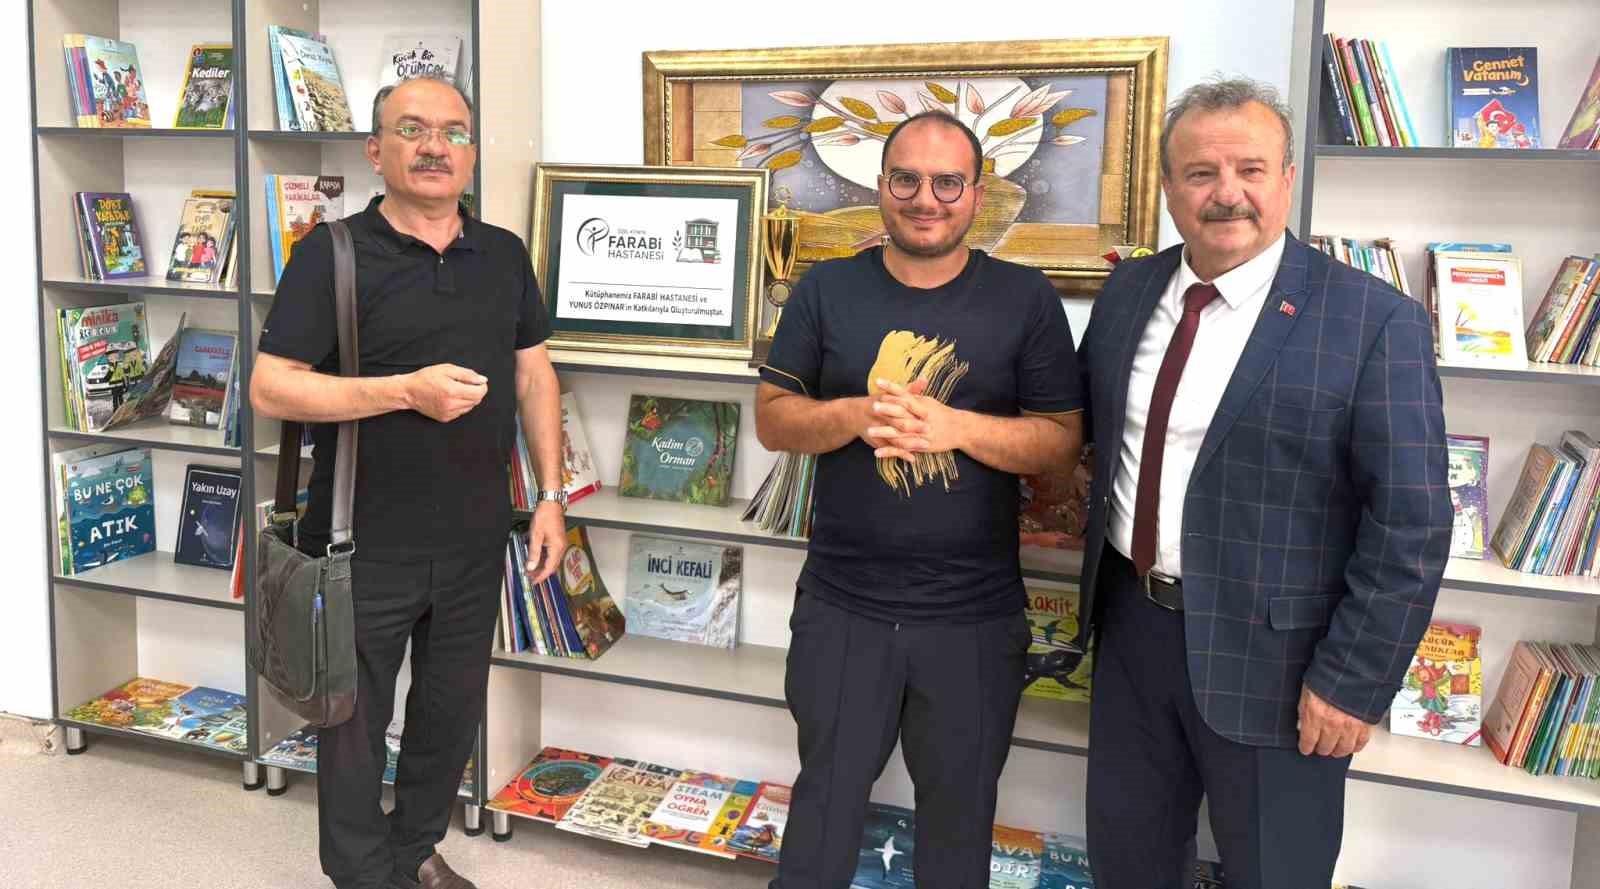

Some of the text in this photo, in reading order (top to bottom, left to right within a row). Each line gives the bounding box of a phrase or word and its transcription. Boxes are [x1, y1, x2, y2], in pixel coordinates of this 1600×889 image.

[421, 49, 435, 61] Bir
[1473, 55, 1526, 72] Cennet
[192, 66, 231, 79] Kediler
[1463, 69, 1522, 82] Vatanım
[585, 289, 708, 304] Kütüphanemiz FARABİ HASTANESİ ve
[569, 301, 593, 310] YUNUS
[633, 303, 669, 315] Katkılarıyla
[81, 307, 119, 328] minika
[651, 437, 684, 452] Kadim
[660, 451, 696, 466] Orman
[73, 474, 144, 502] BU NE ÇOK
[192, 481, 237, 500] Yakın Uzay
[90, 515, 139, 544] ATIK
[648, 553, 713, 579] İNCİ KEFALİ
[673, 793, 708, 807] OYNA
[675, 784, 725, 800] STEAM
[991, 840, 1034, 858] AVA
[1050, 850, 1090, 868] BU N
